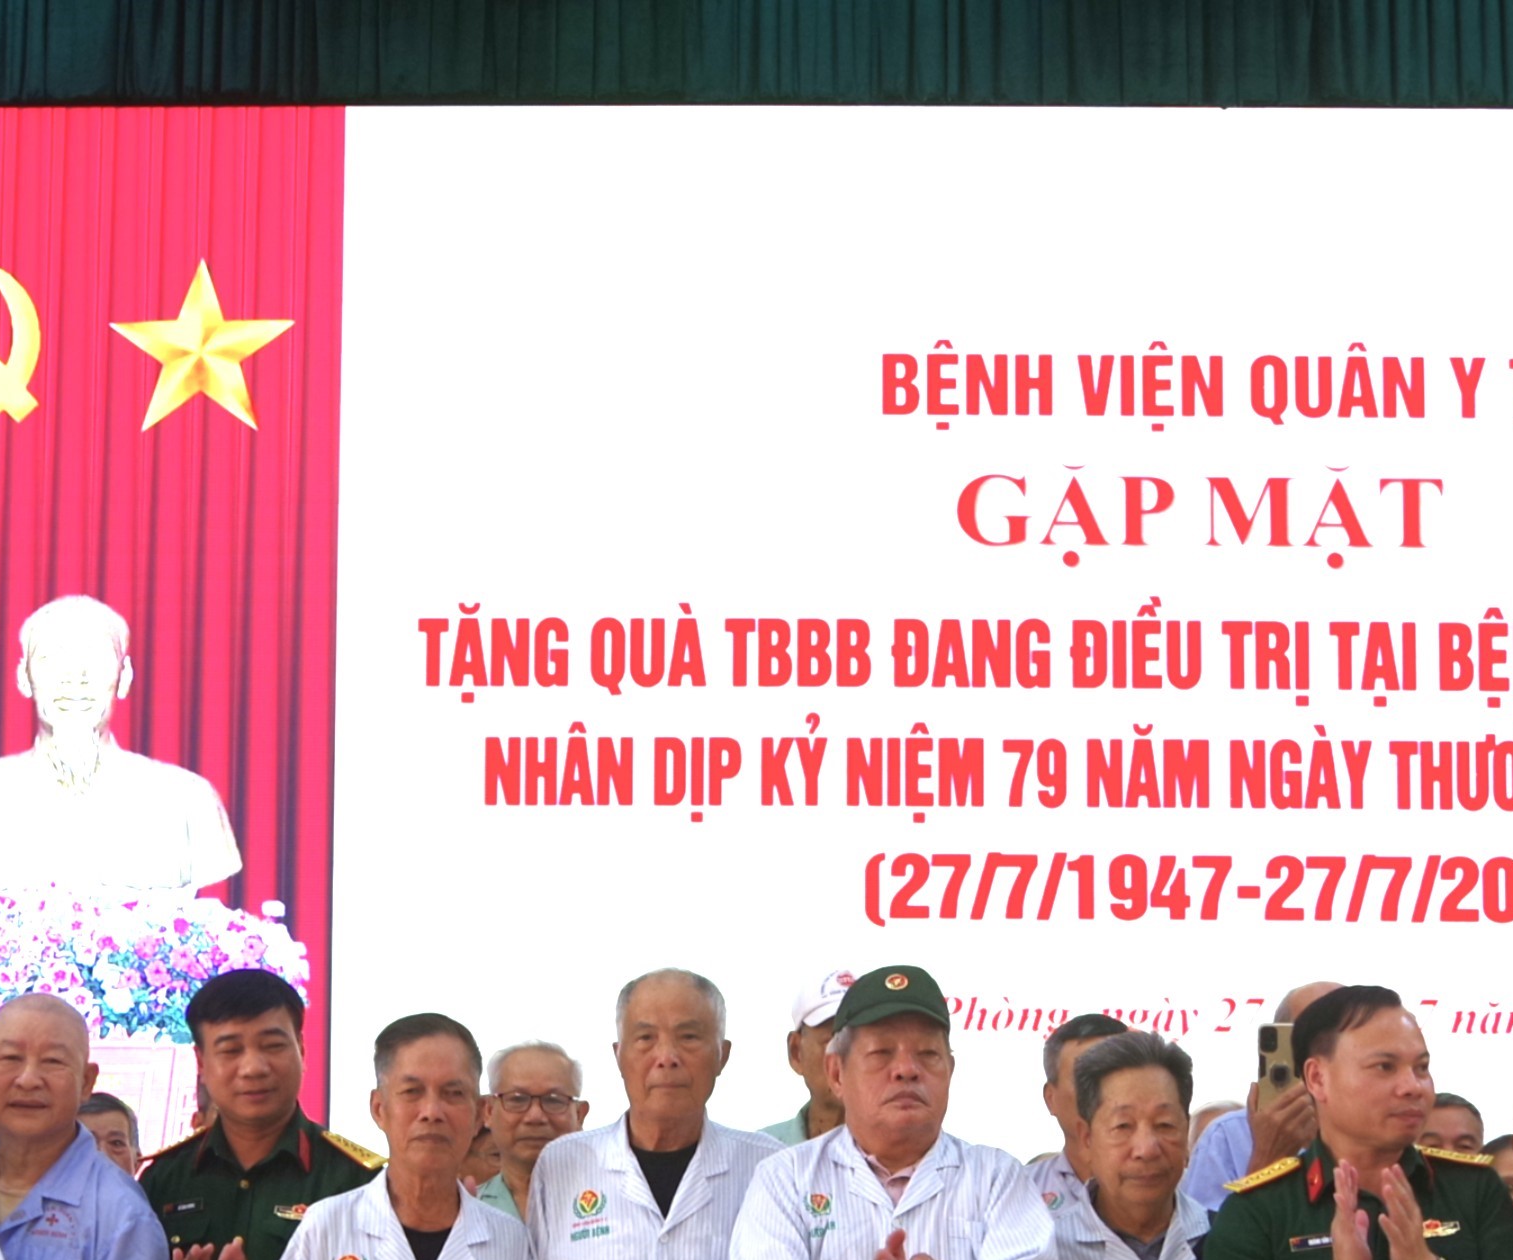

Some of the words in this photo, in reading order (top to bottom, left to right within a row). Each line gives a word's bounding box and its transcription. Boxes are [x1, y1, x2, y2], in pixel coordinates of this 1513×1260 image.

[882, 339, 1052, 431] BỆNH
[1078, 340, 1223, 432] VIỆN
[1251, 341, 1425, 425] QUÂN
[1450, 357, 1485, 419] Y
[956, 464, 1175, 568] GẶP
[1206, 466, 1444, 569] MẶT
[418, 602, 569, 704] TẶNG
[590, 602, 707, 696] QUÀ
[725, 617, 872, 688] TBBB
[890, 617, 1051, 689] ĐANG
[1070, 596, 1202, 690] ĐIỀU
[1221, 620, 1310, 706] TRỊ
[1329, 621, 1417, 707] TẠI
[484, 721, 634, 807] NHÂN
[653, 737, 743, 823] DỊP
[760, 712, 828, 807] KỶ
[846, 722, 985, 824] NIỆM
[1002, 737, 1068, 809] 79
[1086, 723, 1210, 809] NĂM
[1229, 724, 1373, 811] NGÀY
[1214, 998, 1265, 1033] 27
